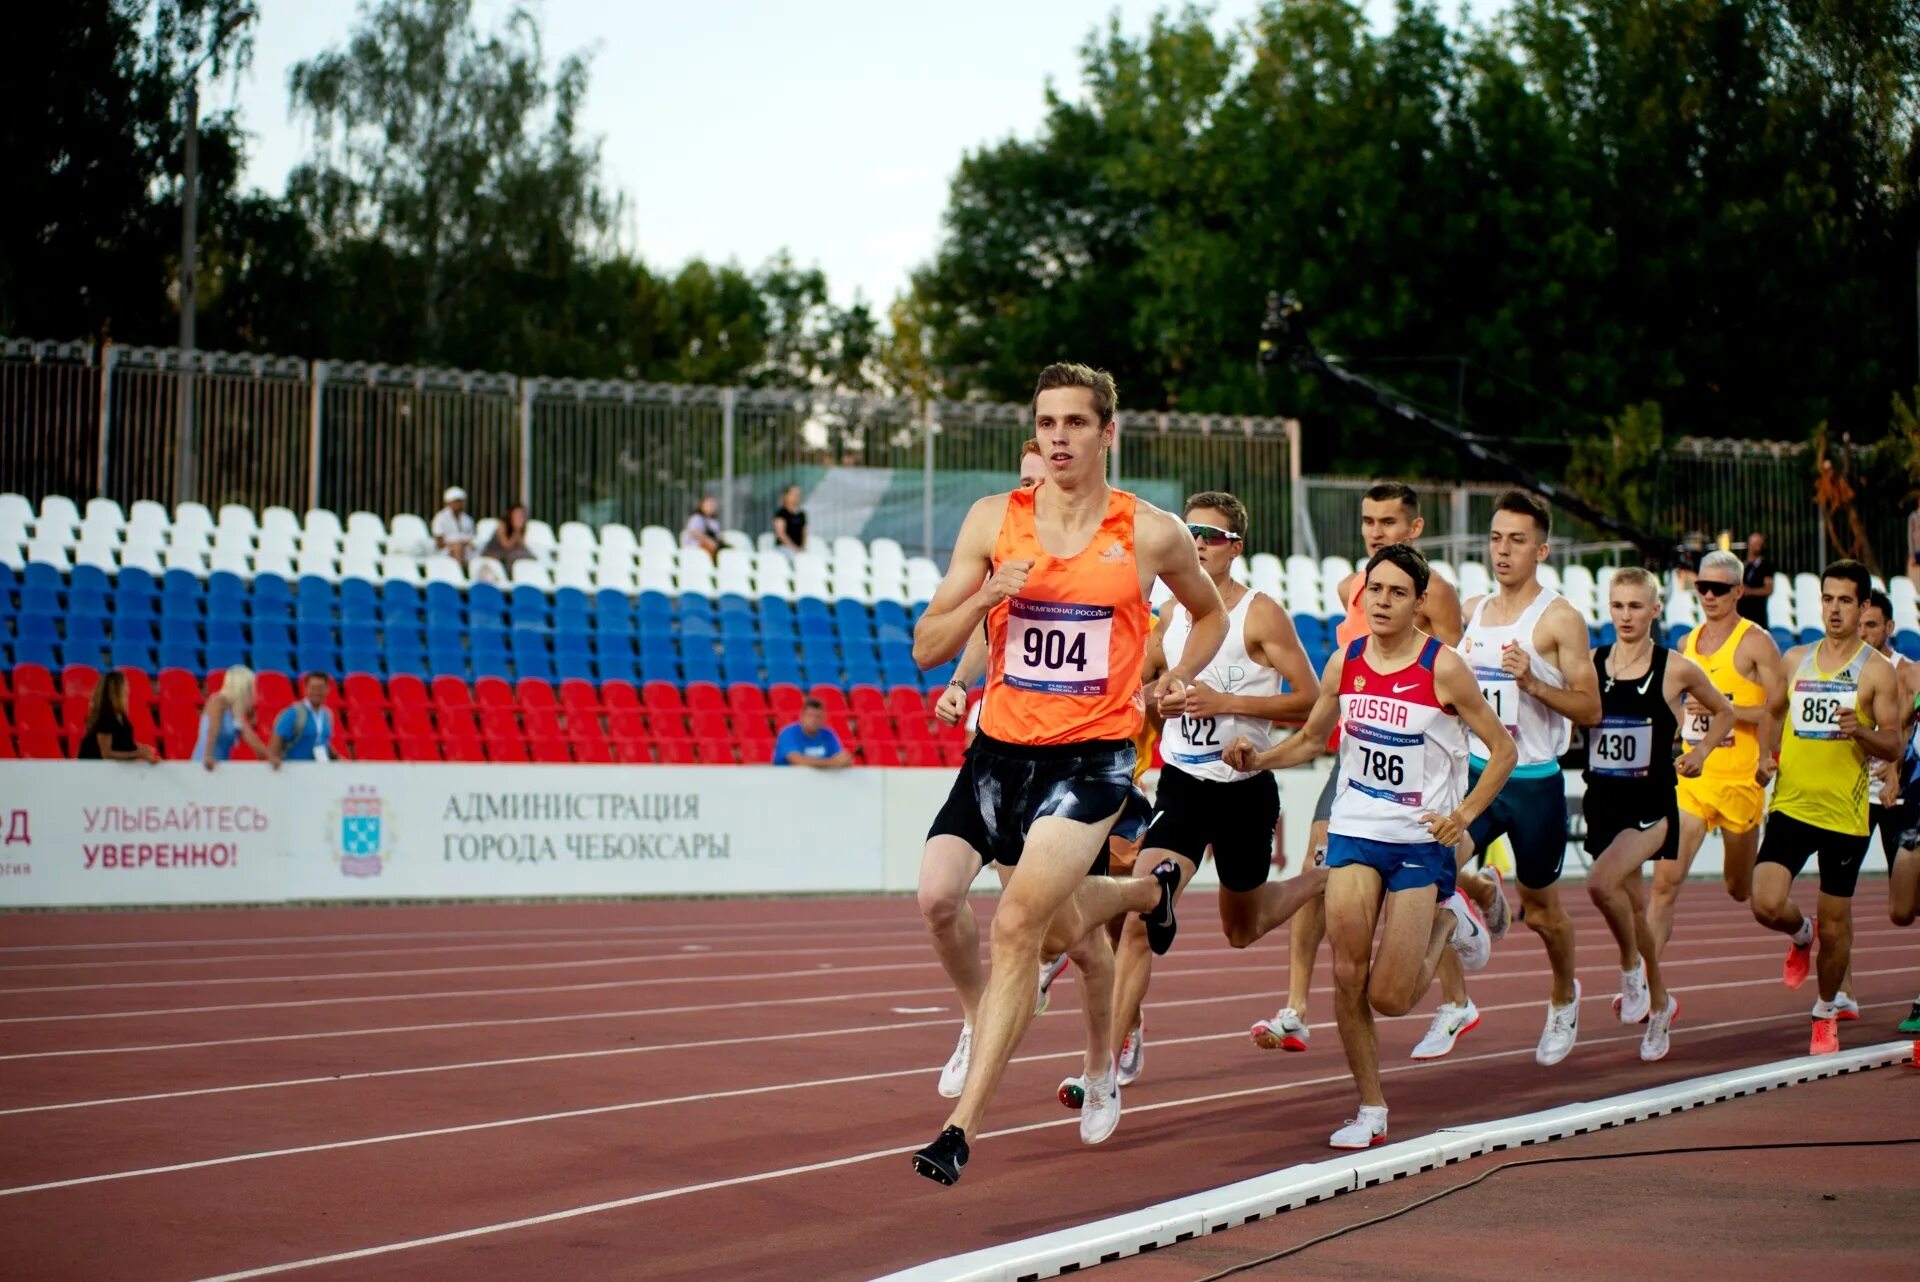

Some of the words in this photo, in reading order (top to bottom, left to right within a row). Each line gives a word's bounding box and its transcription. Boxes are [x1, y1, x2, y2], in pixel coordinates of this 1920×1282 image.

[1027, 605, 1073, 615] ЧЕМПИОНАТ
[1023, 627, 1087, 672] 904
[1349, 698, 1409, 729] RUSSIA
[1802, 697, 1841, 724] 852
[1181, 714, 1220, 746] 422
[1360, 728, 1392, 740] ЧЕМПИОНАТ
[1392, 736, 1419, 744] РОССИИ
[1597, 734, 1636, 762] 430
[1359, 746, 1404, 786] 786
[83, 802, 269, 833] УЛЫБАЙТЕСЬ
[443, 793, 700, 823] АДМИНИСТРАЦИЯ
[0, 809, 32, 848] Д
[82, 843, 238, 869] УВЕРЕННО!
[443, 834, 557, 865] ГОРОДА
[565, 832, 731, 861] ЧЕБОКСАРЫ
